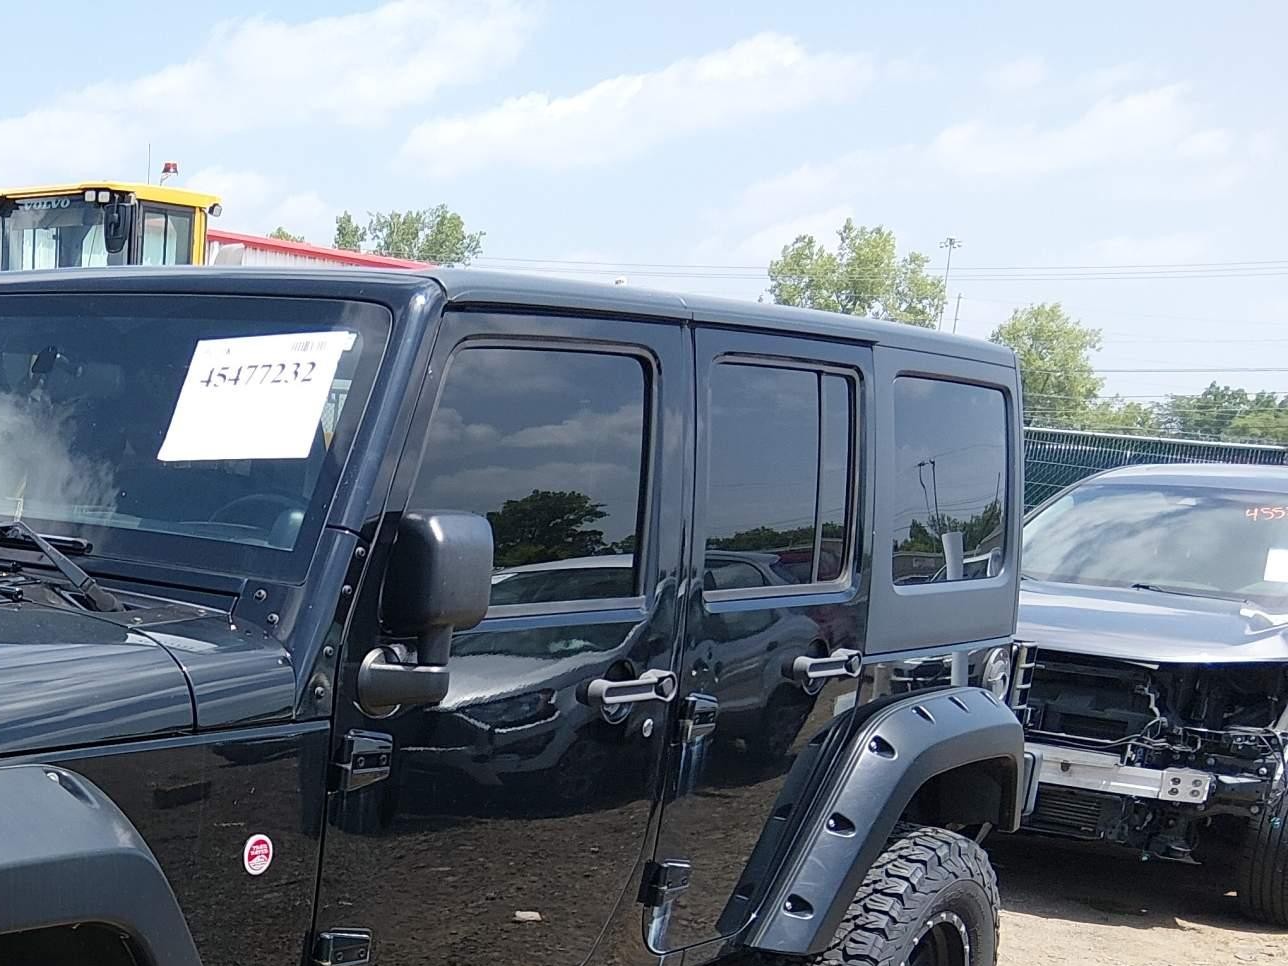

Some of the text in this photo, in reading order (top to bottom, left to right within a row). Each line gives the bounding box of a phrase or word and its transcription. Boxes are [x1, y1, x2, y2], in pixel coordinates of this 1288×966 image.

[23, 198, 71, 211] VOLVO
[200, 361, 317, 388] 45477232
[1245, 506, 1288, 521] 455
